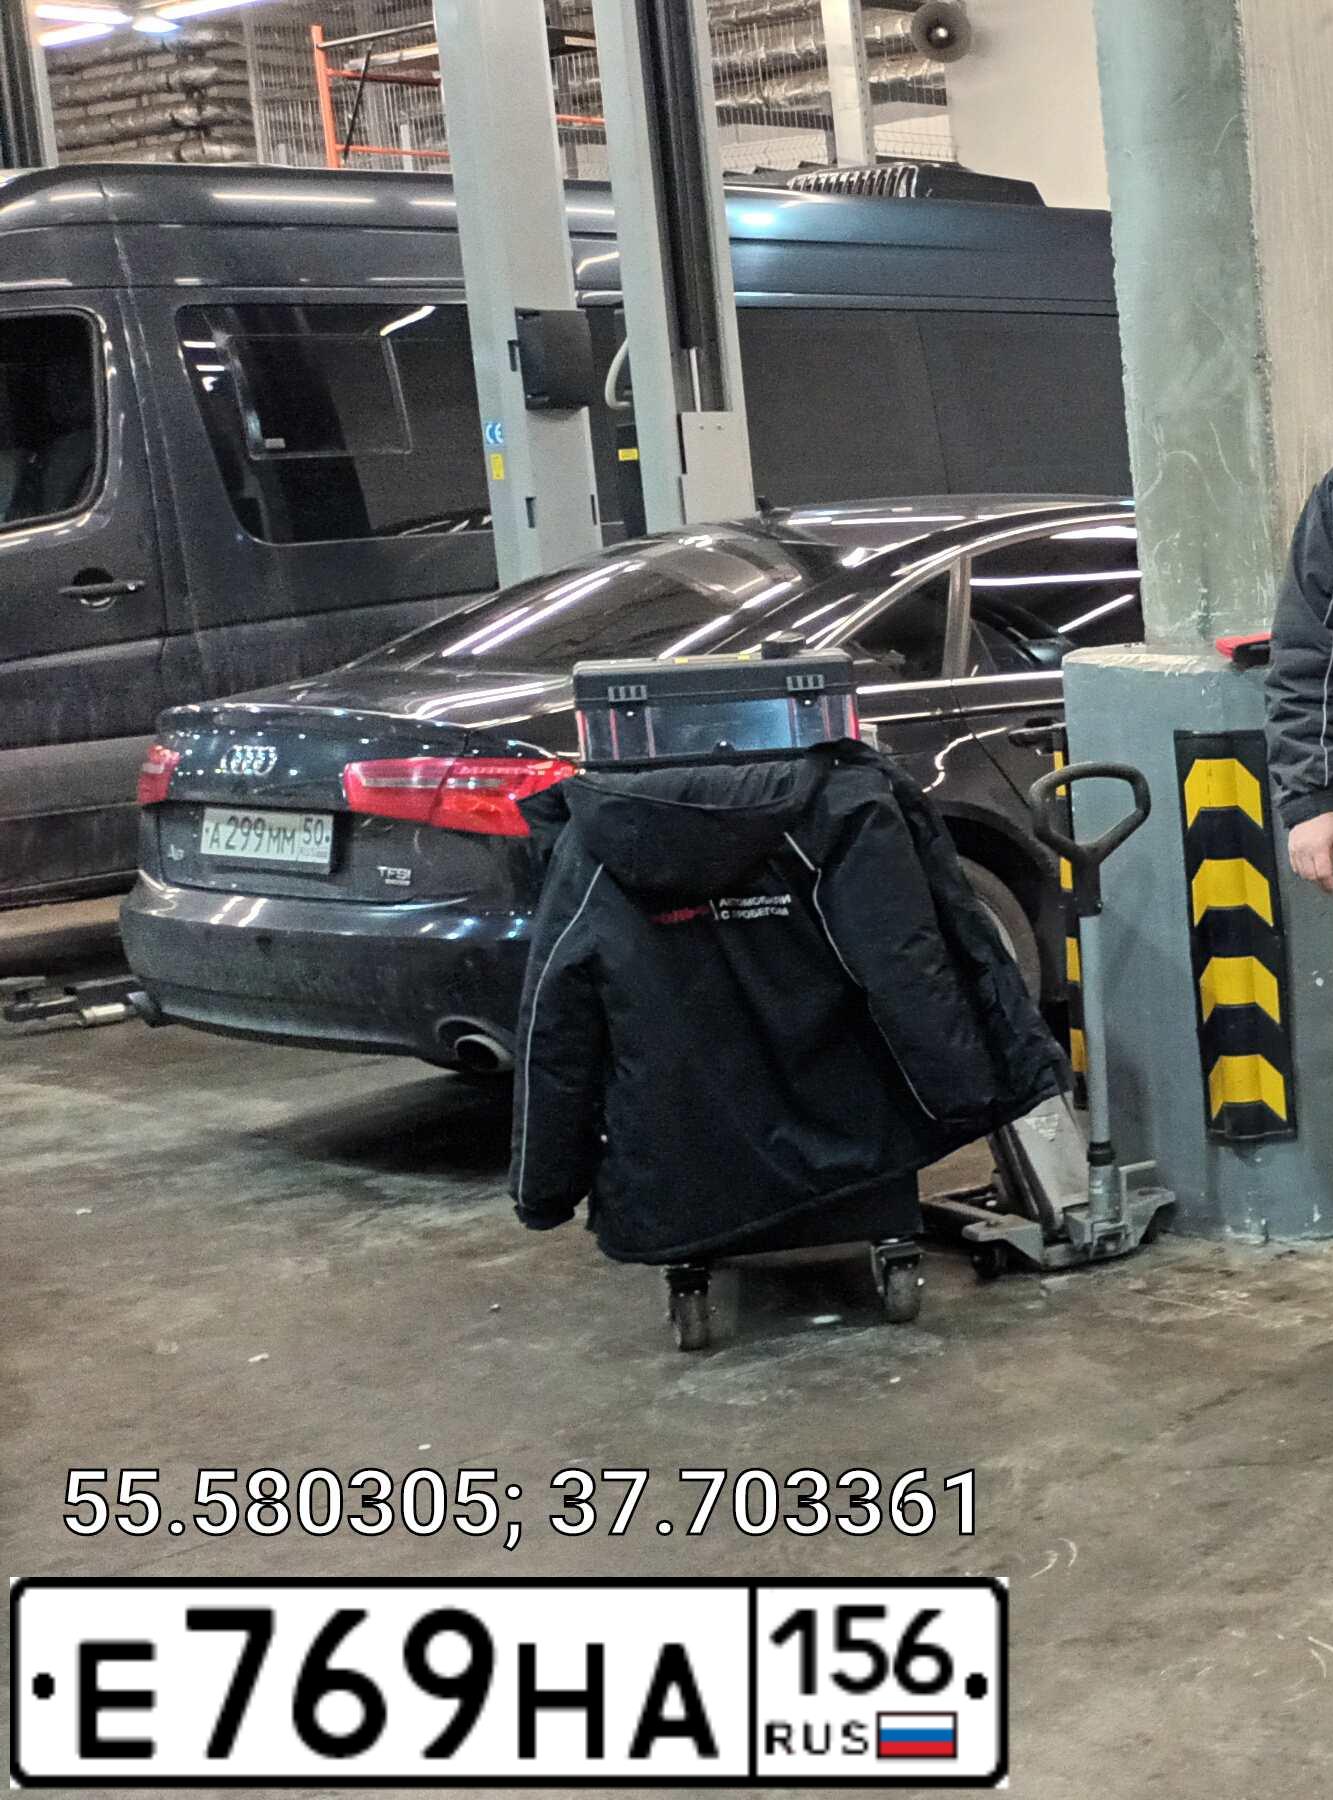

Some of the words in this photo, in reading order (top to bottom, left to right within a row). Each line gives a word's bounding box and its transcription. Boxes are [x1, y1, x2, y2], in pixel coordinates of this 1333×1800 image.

[209, 815, 296, 854] А299ММ
[302, 817, 325, 847] 50
[377, 866, 411, 880] TFSI
[720, 910, 730, 920] С
